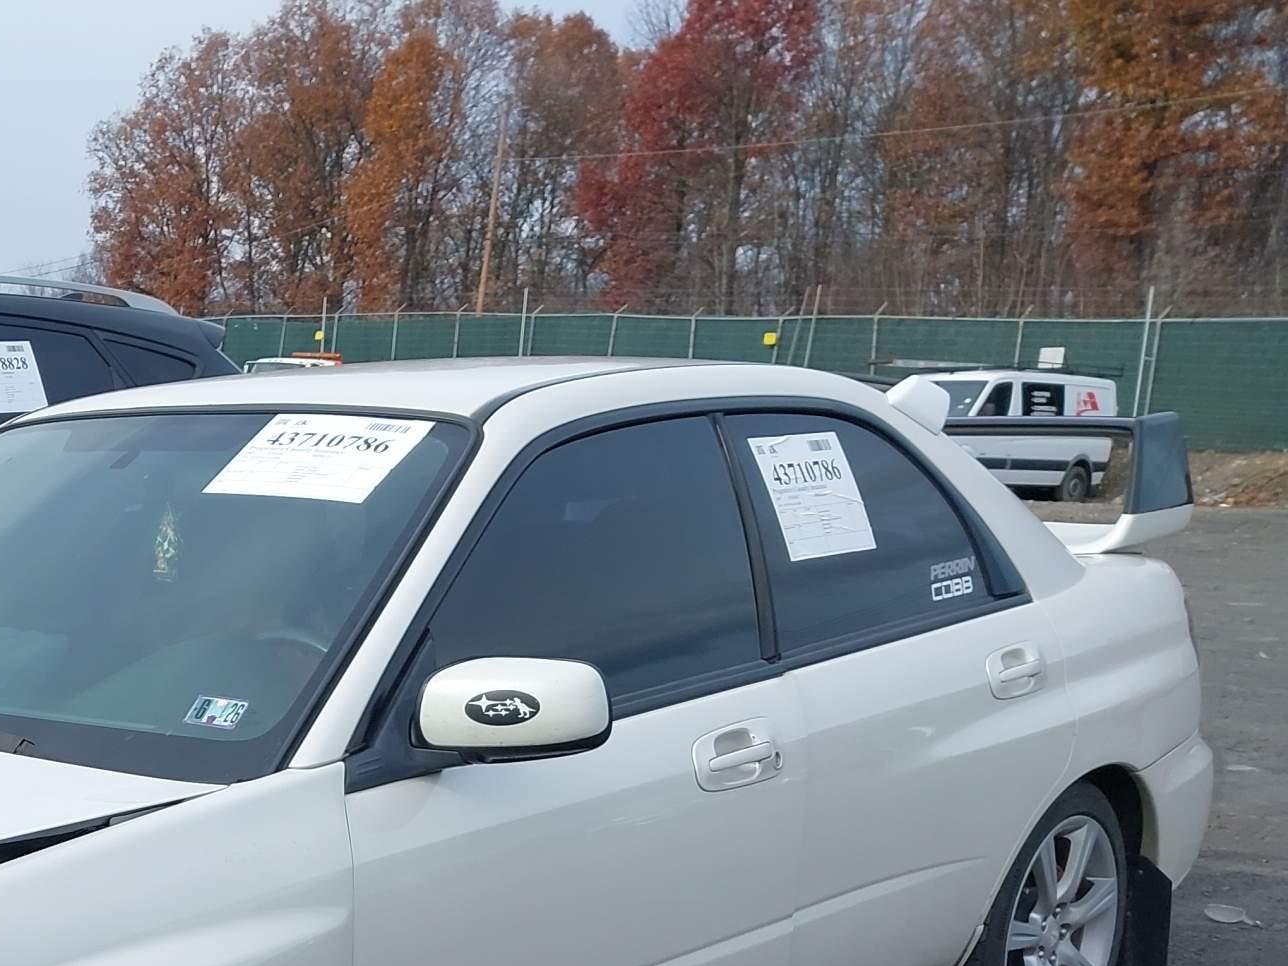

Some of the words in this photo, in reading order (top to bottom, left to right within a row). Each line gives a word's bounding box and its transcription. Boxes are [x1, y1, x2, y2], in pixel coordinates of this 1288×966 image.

[266, 431, 395, 455] 43710786
[773, 458, 843, 486] 43710786
[931, 575, 974, 601] COBB
[224, 703, 246, 724] 26
